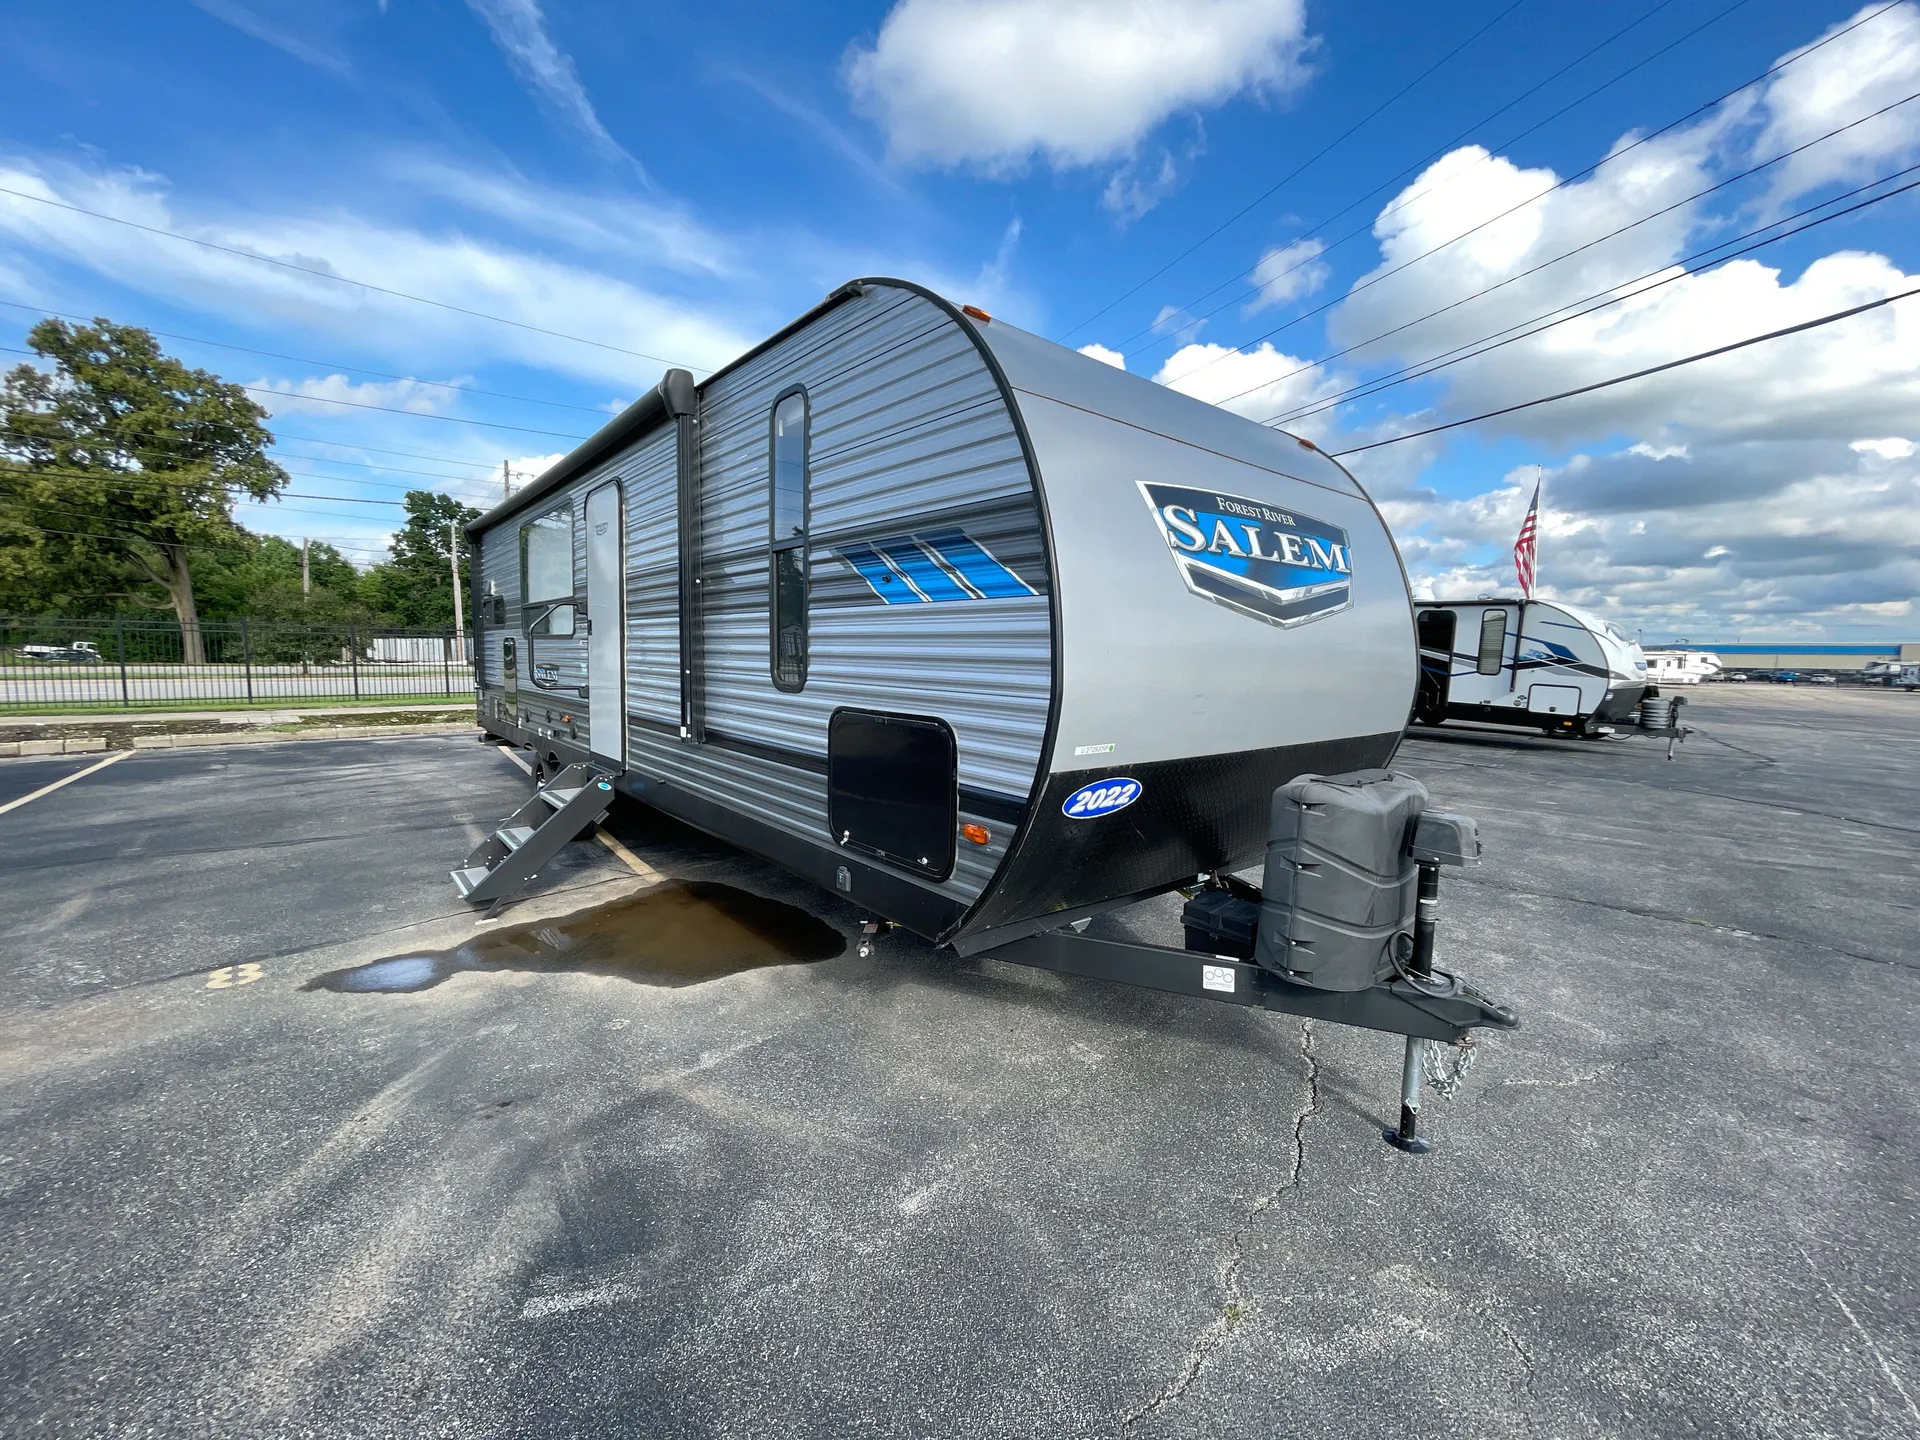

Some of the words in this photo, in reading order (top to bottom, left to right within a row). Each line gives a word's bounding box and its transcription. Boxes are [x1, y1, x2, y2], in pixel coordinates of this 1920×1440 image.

[1215, 496, 1262, 519] FOREST
[1261, 507, 1297, 527] RIVER
[1162, 504, 1351, 573] SALEM
[1068, 783, 1137, 814] 2022
